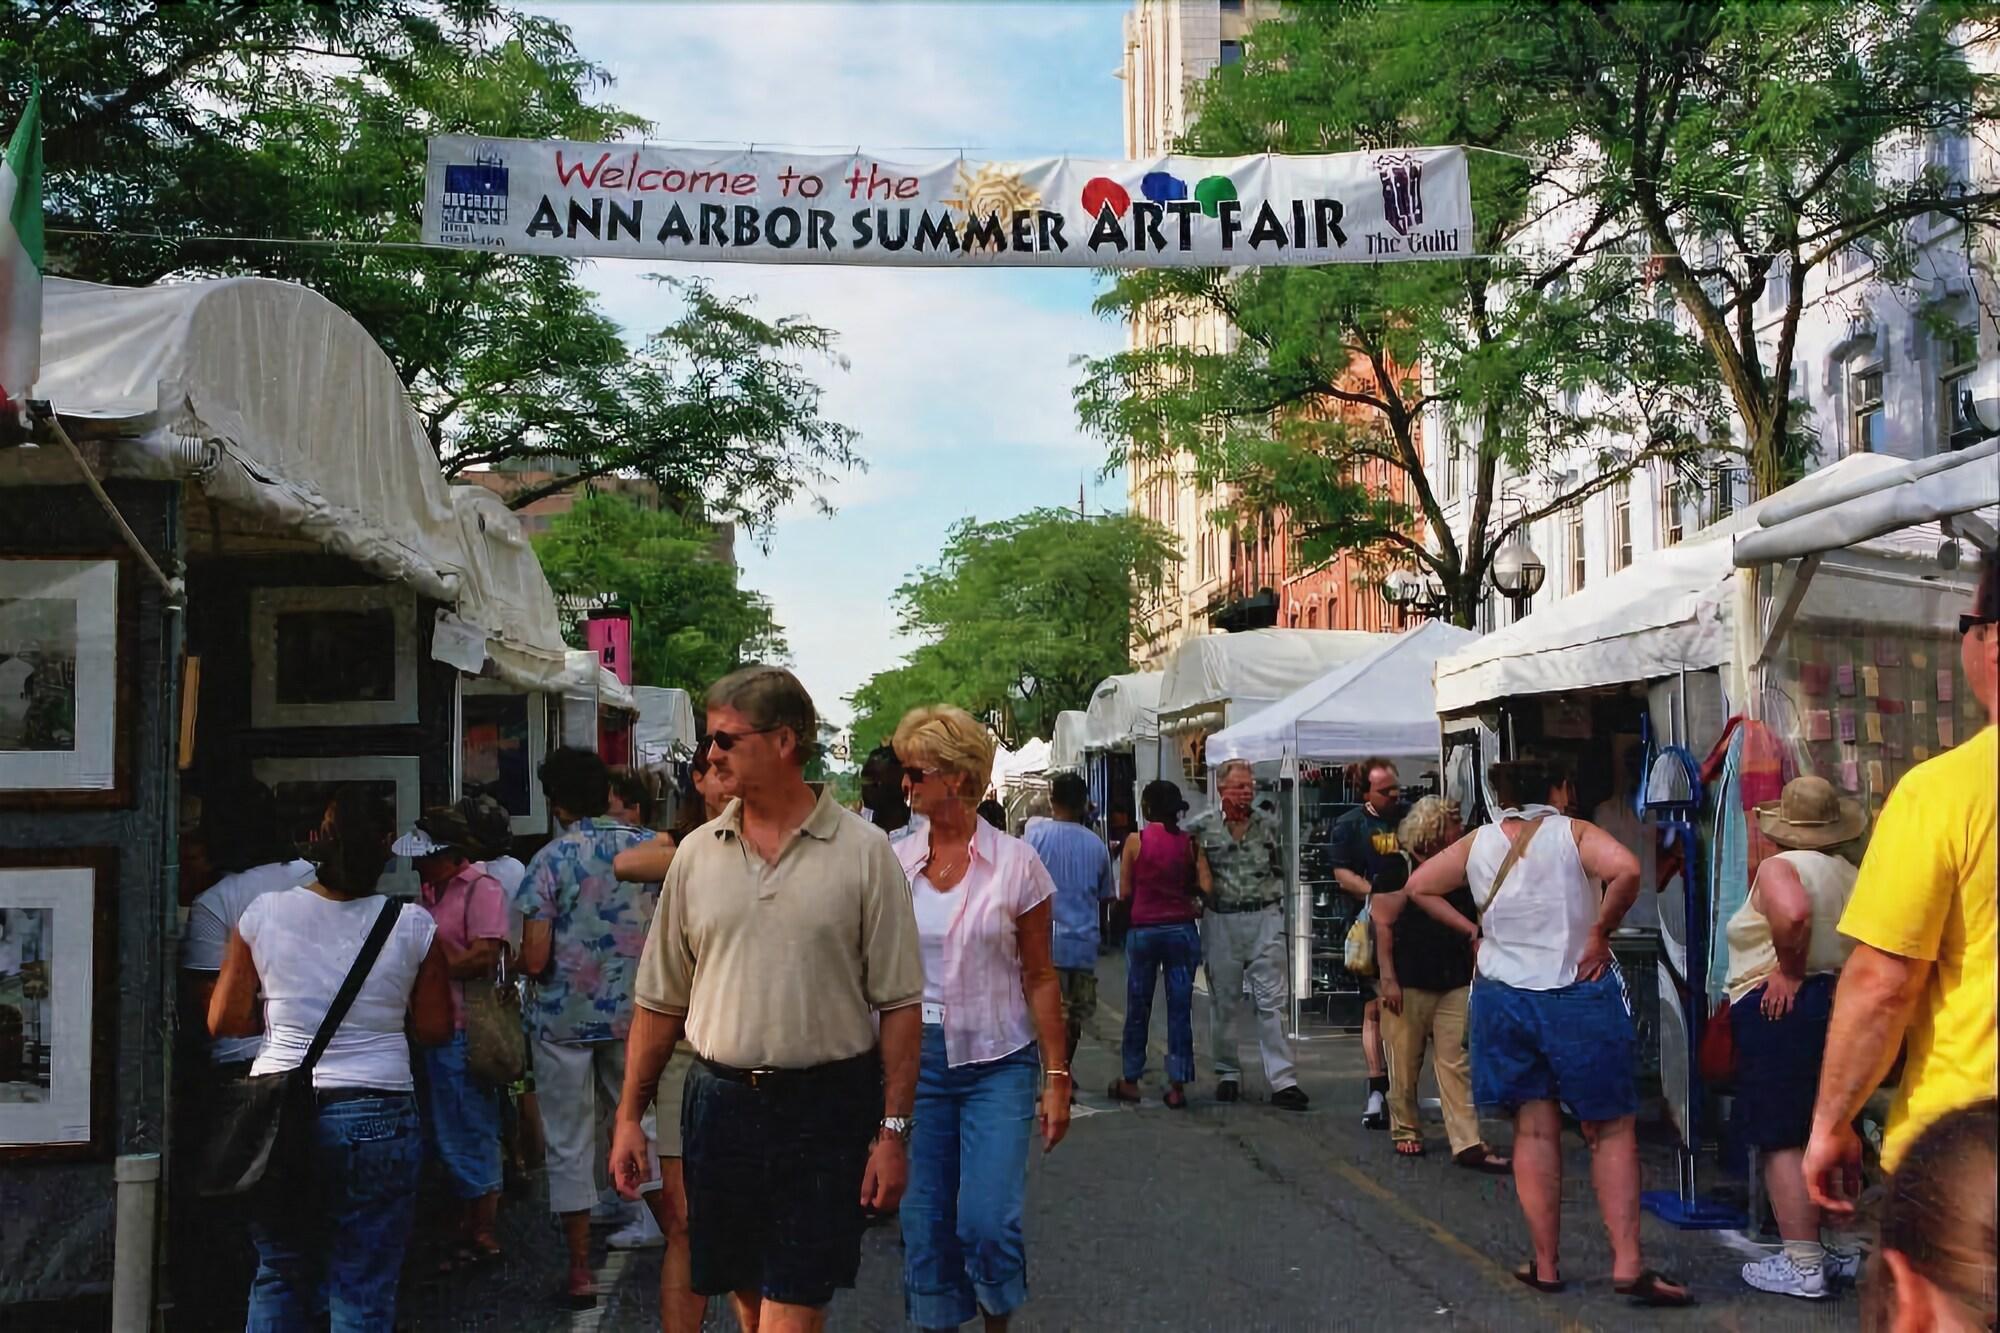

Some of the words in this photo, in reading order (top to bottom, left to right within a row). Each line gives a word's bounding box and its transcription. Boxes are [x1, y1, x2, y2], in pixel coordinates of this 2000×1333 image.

[556, 150, 758, 196] Welcome
[777, 165, 824, 198] to
[845, 162, 919, 200] the
[525, 194, 643, 243] ANN
[656, 200, 838, 252] ARBOR
[852, 207, 1069, 254] SUMMER
[1087, 198, 1201, 253] ART
[1219, 199, 1348, 250] FAIR
[1365, 231, 1400, 255] The
[1407, 229, 1458, 255] Guild
